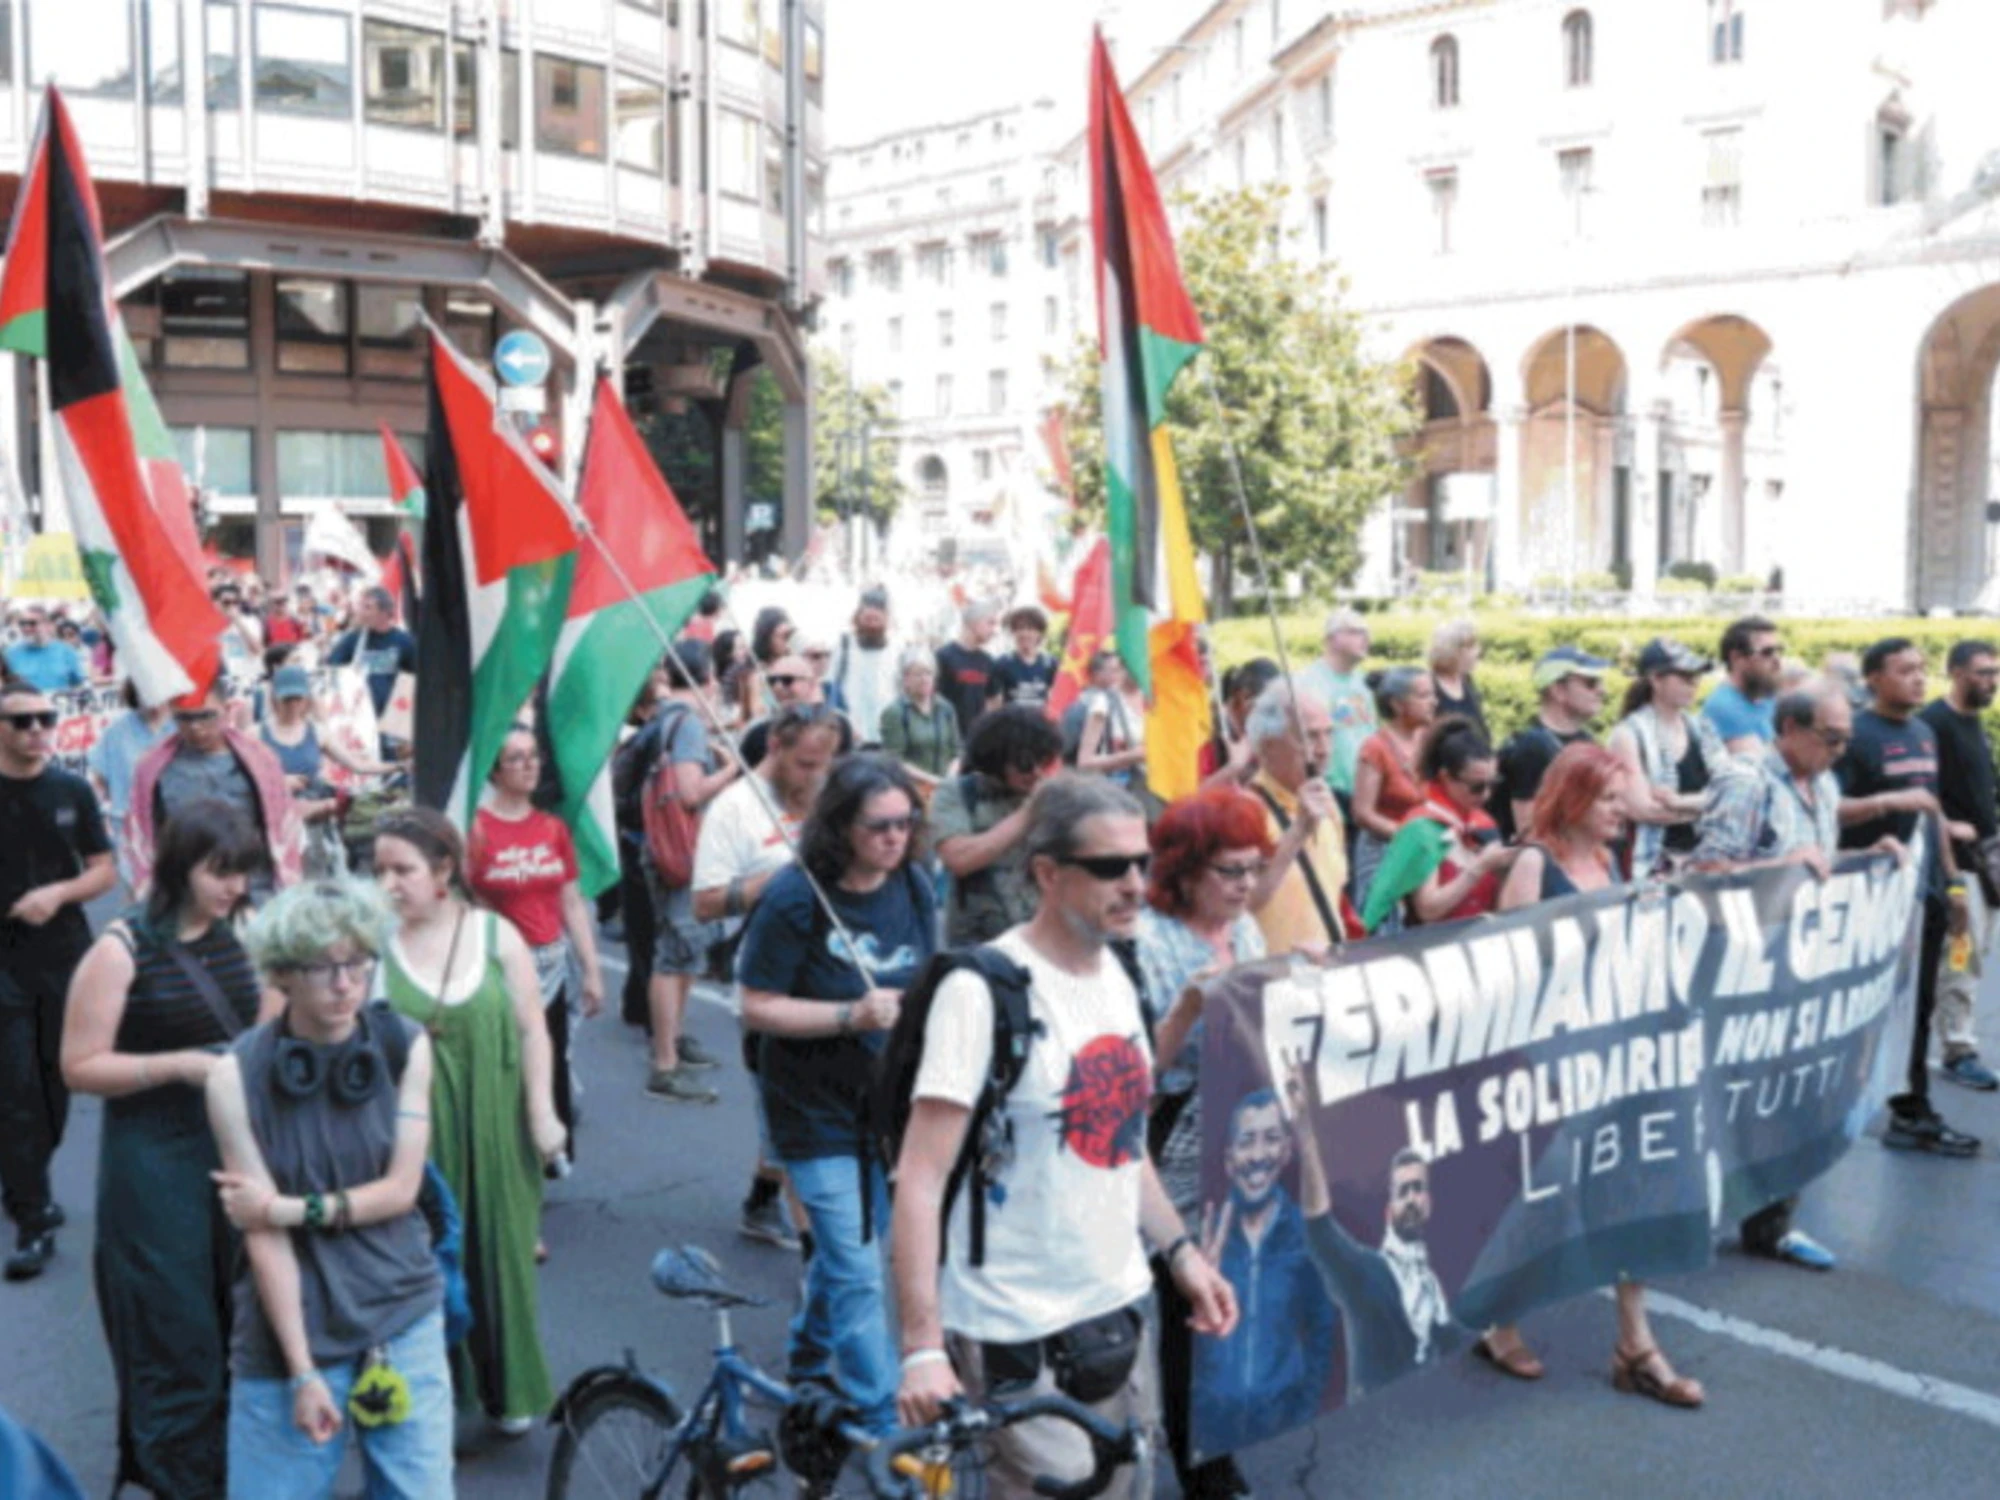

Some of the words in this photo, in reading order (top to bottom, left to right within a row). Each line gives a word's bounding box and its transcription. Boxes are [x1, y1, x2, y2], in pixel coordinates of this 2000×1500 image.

[1263, 889, 1709, 1119] FERMIAMO
[1712, 888, 1776, 998] IL
[1406, 1091, 1463, 1163] LA
[1713, 1005, 1793, 1066] NON
